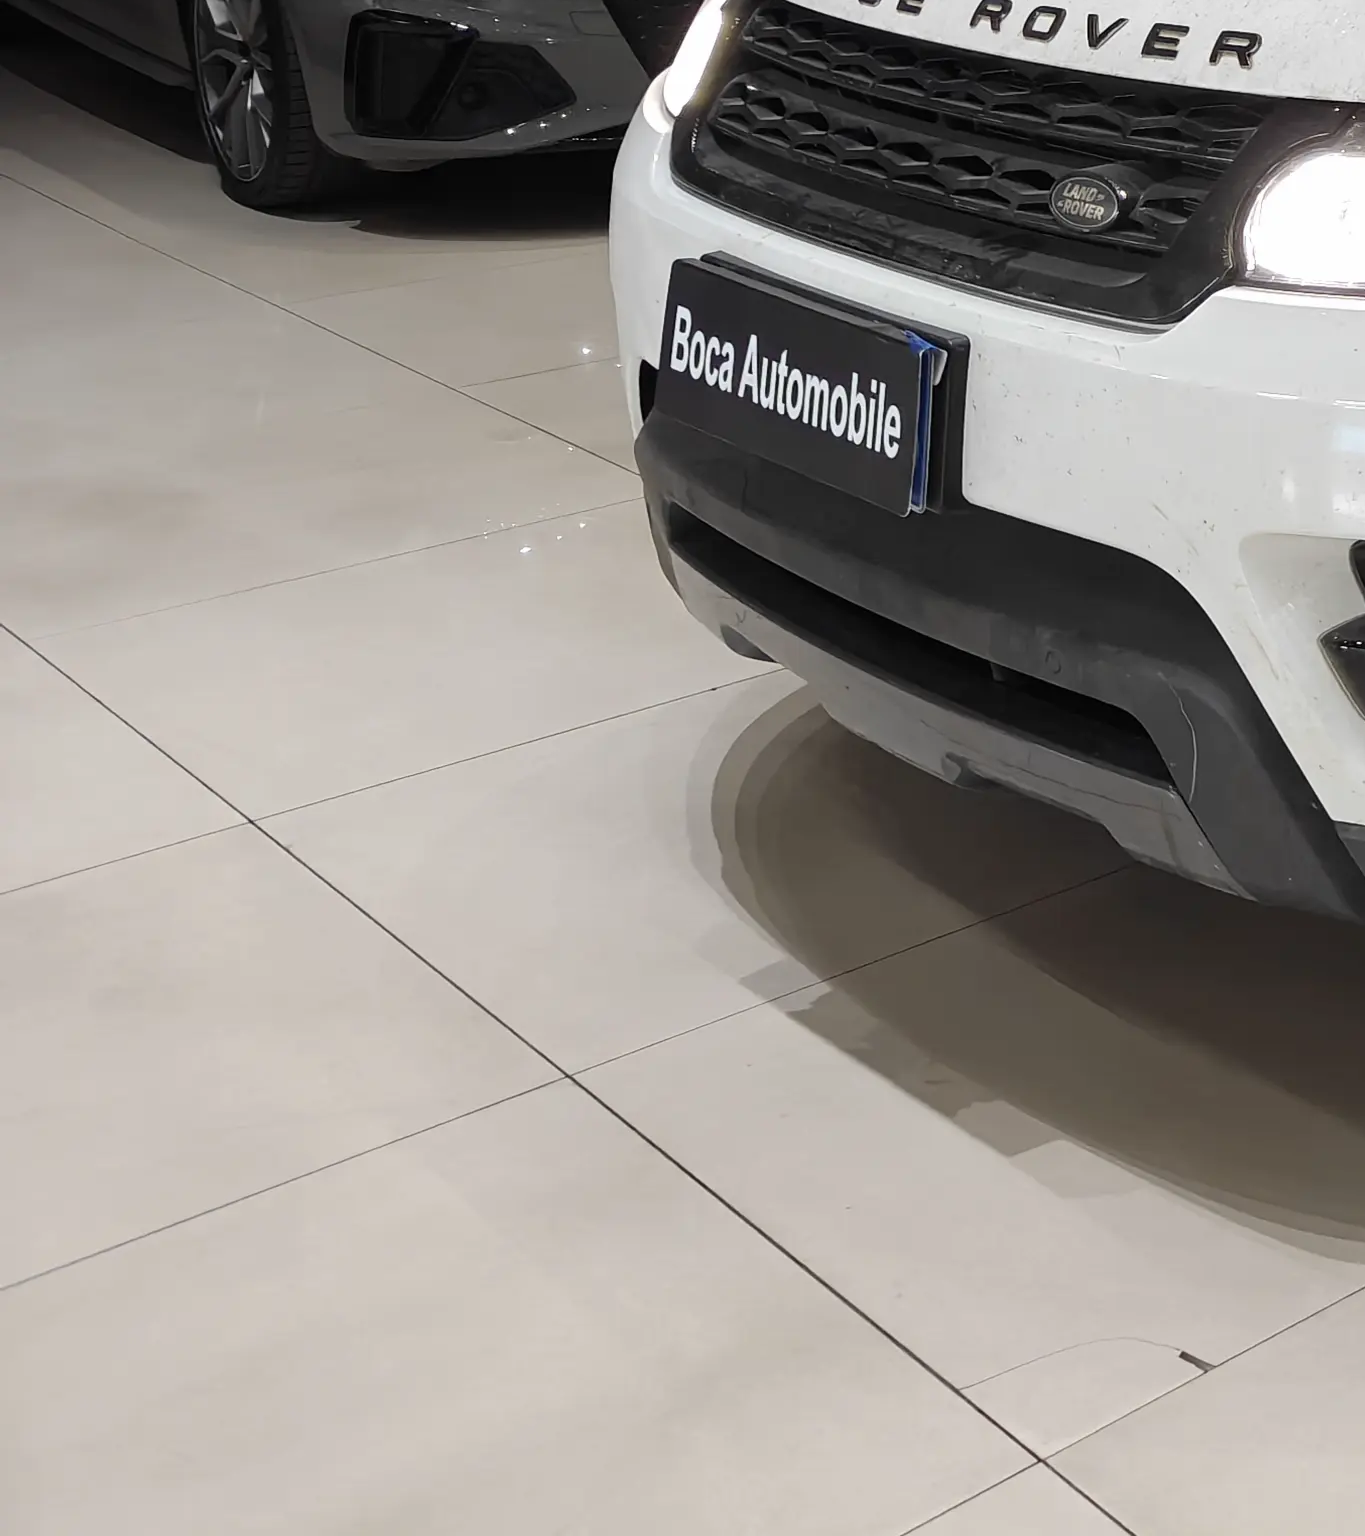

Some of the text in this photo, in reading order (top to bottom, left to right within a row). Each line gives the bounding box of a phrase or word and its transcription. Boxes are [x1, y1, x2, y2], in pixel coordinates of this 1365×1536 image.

[1063, 182, 1098, 203] LAND
[1062, 198, 1105, 221] ROVER
[670, 305, 901, 459] Boca Automobile
